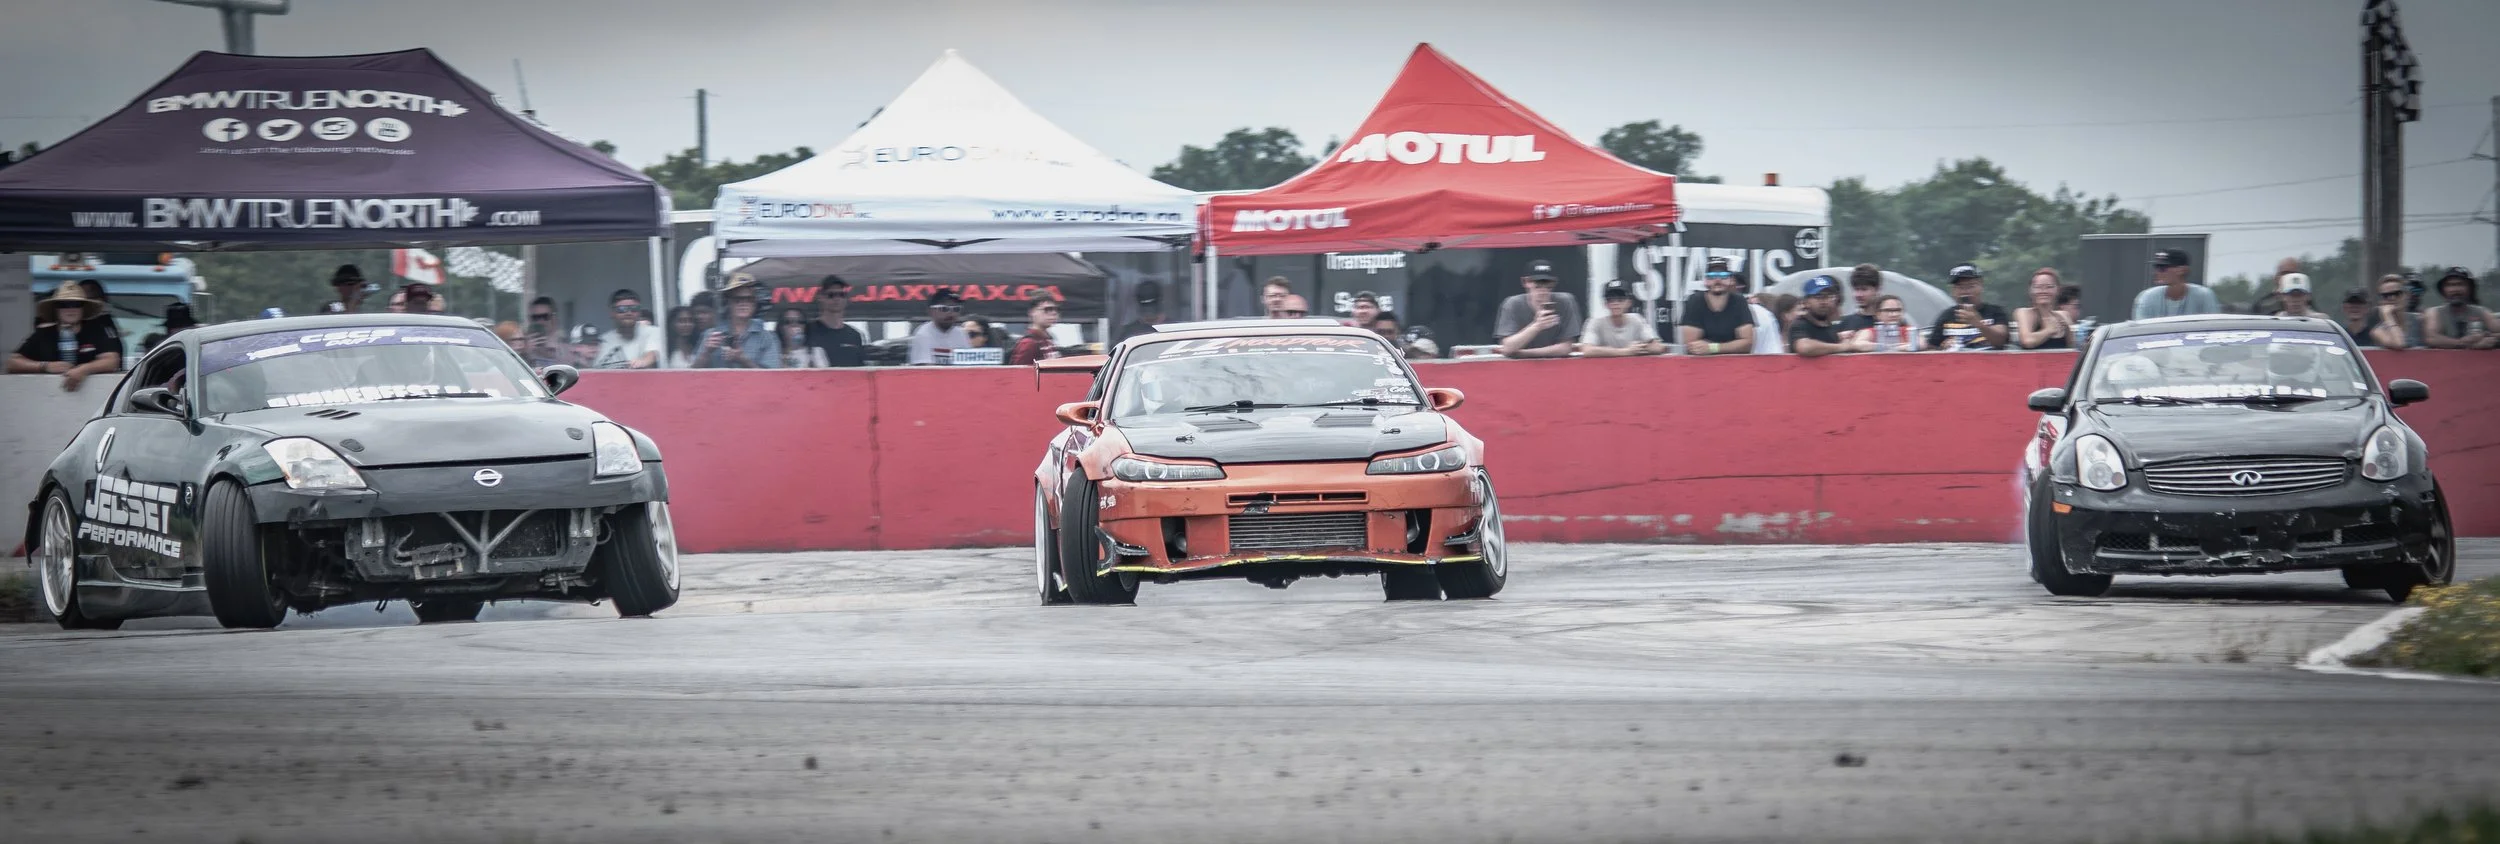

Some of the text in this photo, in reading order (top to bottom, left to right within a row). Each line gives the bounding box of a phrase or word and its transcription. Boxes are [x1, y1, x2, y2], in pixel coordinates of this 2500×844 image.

[147, 90, 444, 113] BMWTRUENORTH
[1337, 131, 1546, 164] MOTUL
[144, 198, 461, 228] BMWTRUENORTH
[1232, 208, 1351, 232] MOTUL
[1325, 251, 1407, 275] Transport
[771, 283, 1066, 303] W.JAXAX.CA
[77, 522, 182, 559] PERFORMANCE
